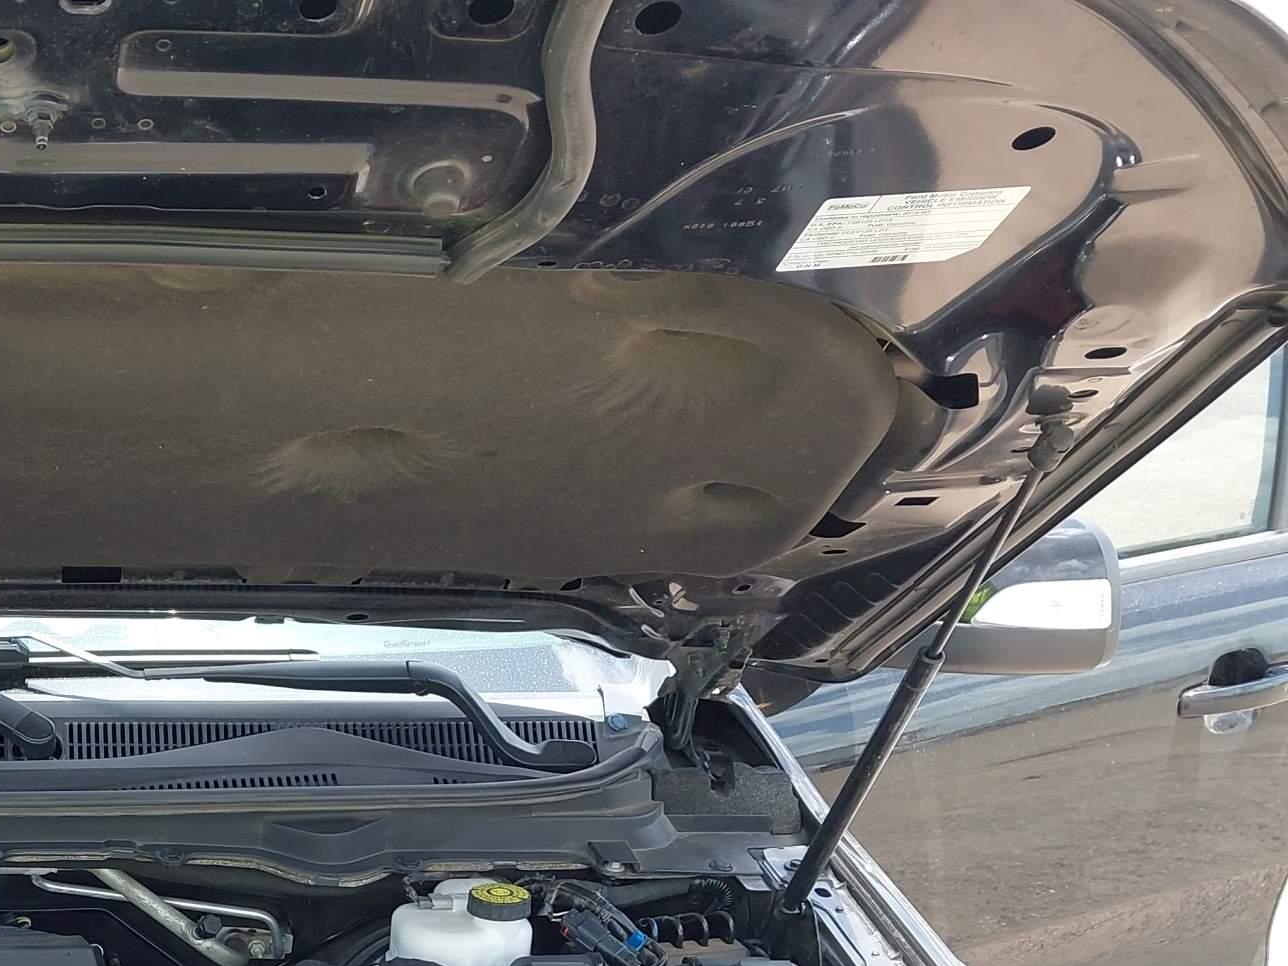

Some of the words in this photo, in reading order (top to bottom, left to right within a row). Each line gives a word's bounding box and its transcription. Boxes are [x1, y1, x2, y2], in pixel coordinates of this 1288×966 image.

[827, 202, 870, 211] FoMoCo
[886, 203, 935, 211] CONTROL
[936, 199, 1008, 208] INFORMATION
[905, 198, 947, 206] VEHICLE
